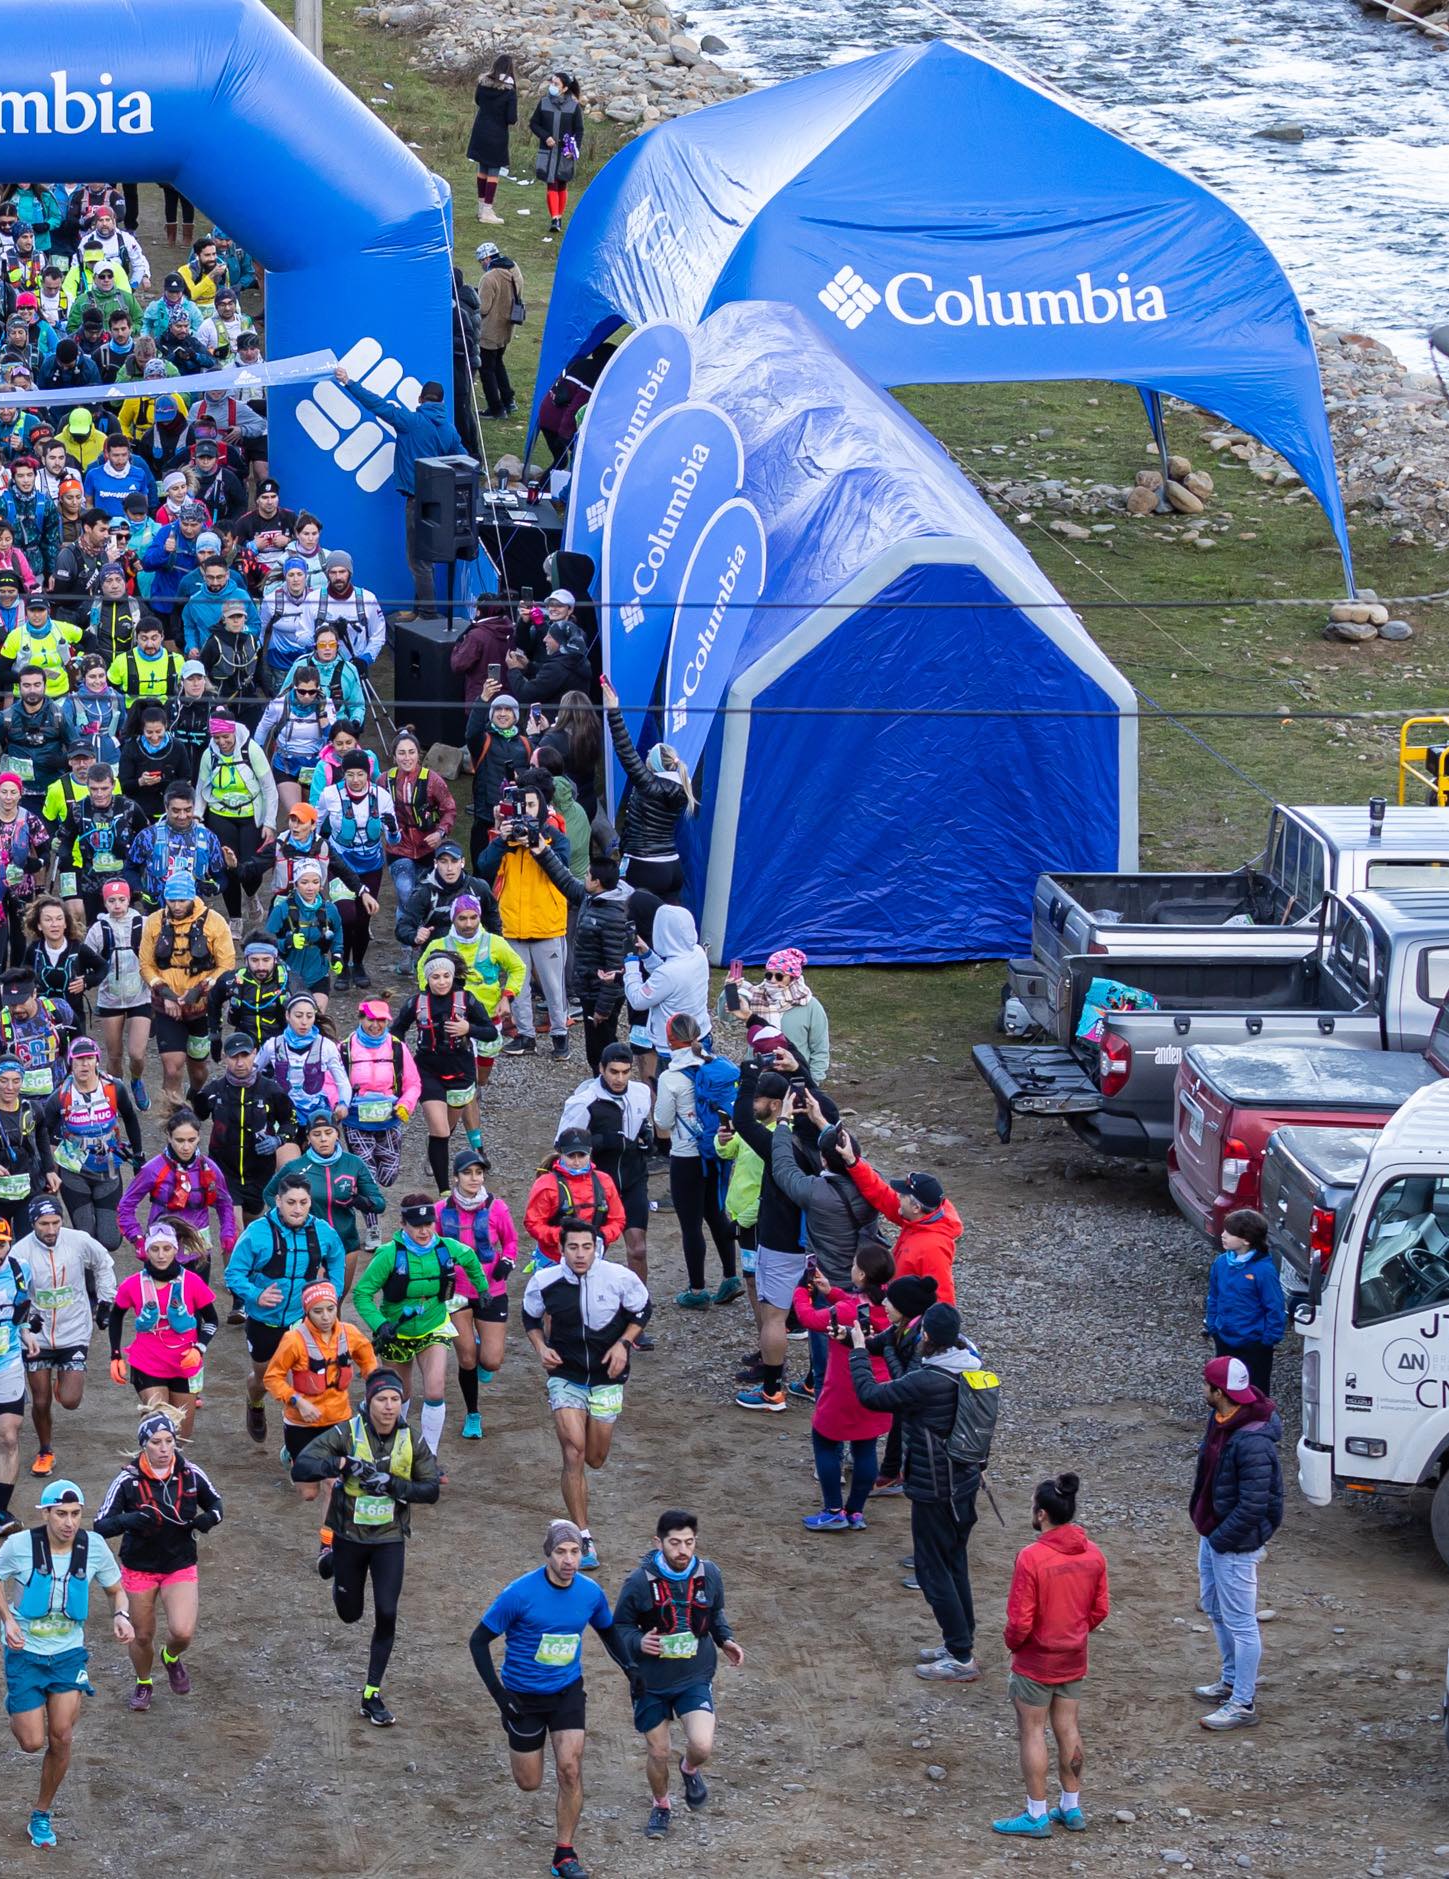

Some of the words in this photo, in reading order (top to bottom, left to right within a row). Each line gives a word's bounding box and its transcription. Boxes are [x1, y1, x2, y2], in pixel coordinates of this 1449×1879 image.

[884, 271, 1168, 327] Columbia
[600, 356, 671, 498] Columbia
[632, 442, 710, 594] Columbia
[682, 544, 747, 698] Columbia
